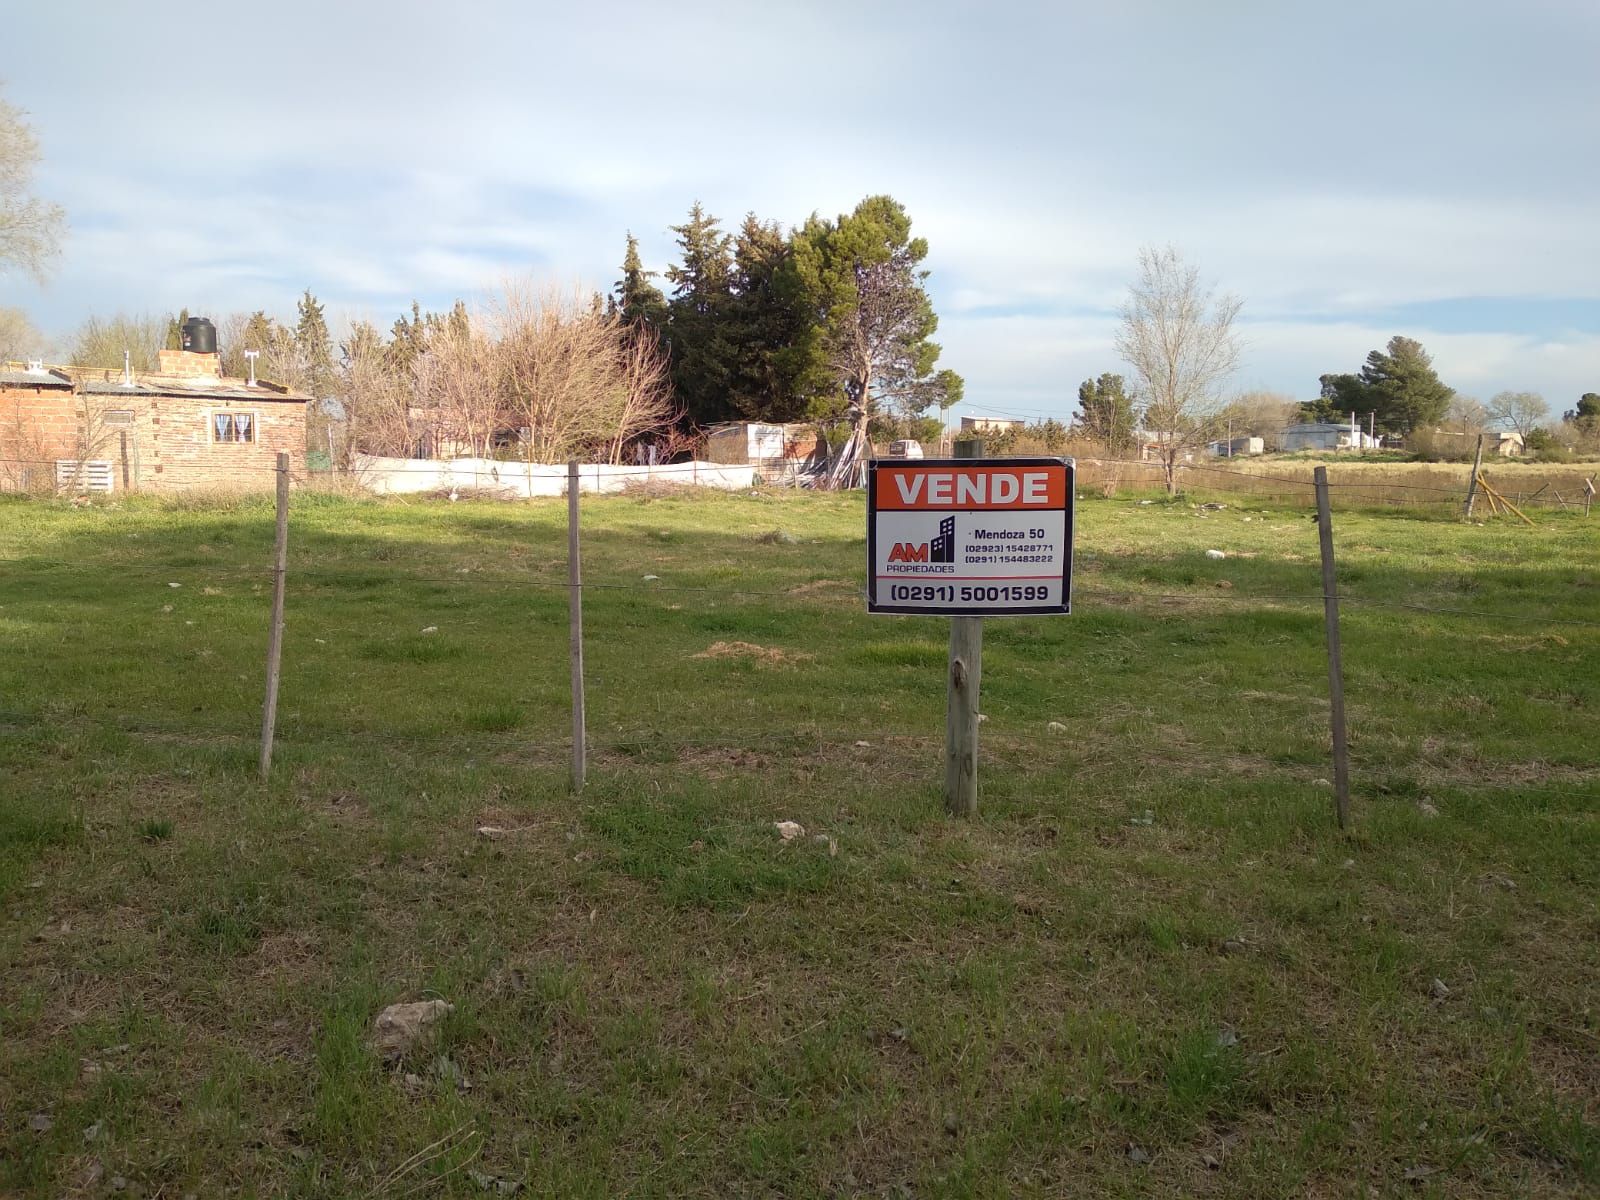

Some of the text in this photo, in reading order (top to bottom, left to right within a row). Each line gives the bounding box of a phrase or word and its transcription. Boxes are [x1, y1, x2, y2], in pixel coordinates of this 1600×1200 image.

[894, 473, 1049, 505] VENDE
[974, 529, 1045, 540] Mendoza 50
[887, 542, 929, 563] AM
[886, 564, 955, 574] PROPIEDADES
[891, 584, 1049, 602] (0291) 5001599
